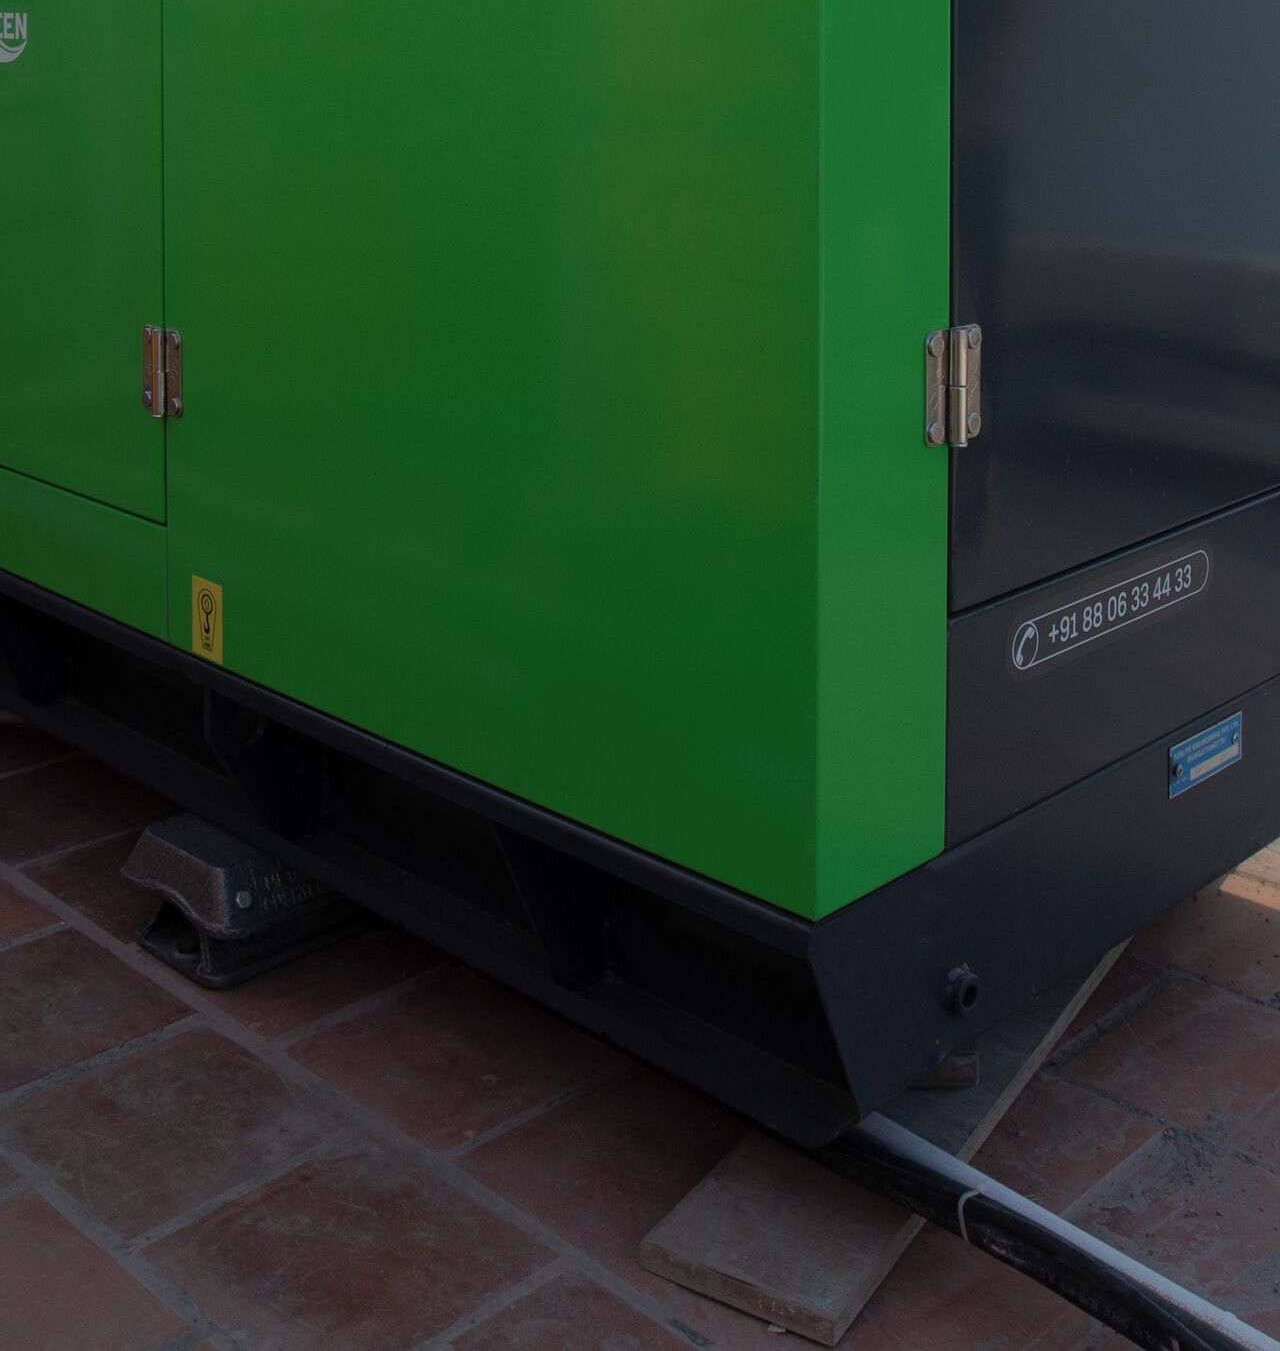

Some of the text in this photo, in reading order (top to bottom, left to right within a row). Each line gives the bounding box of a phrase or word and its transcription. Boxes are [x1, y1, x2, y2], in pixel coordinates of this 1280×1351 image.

[1048, 564, 1192, 643] +91 88 06 33 44 33
